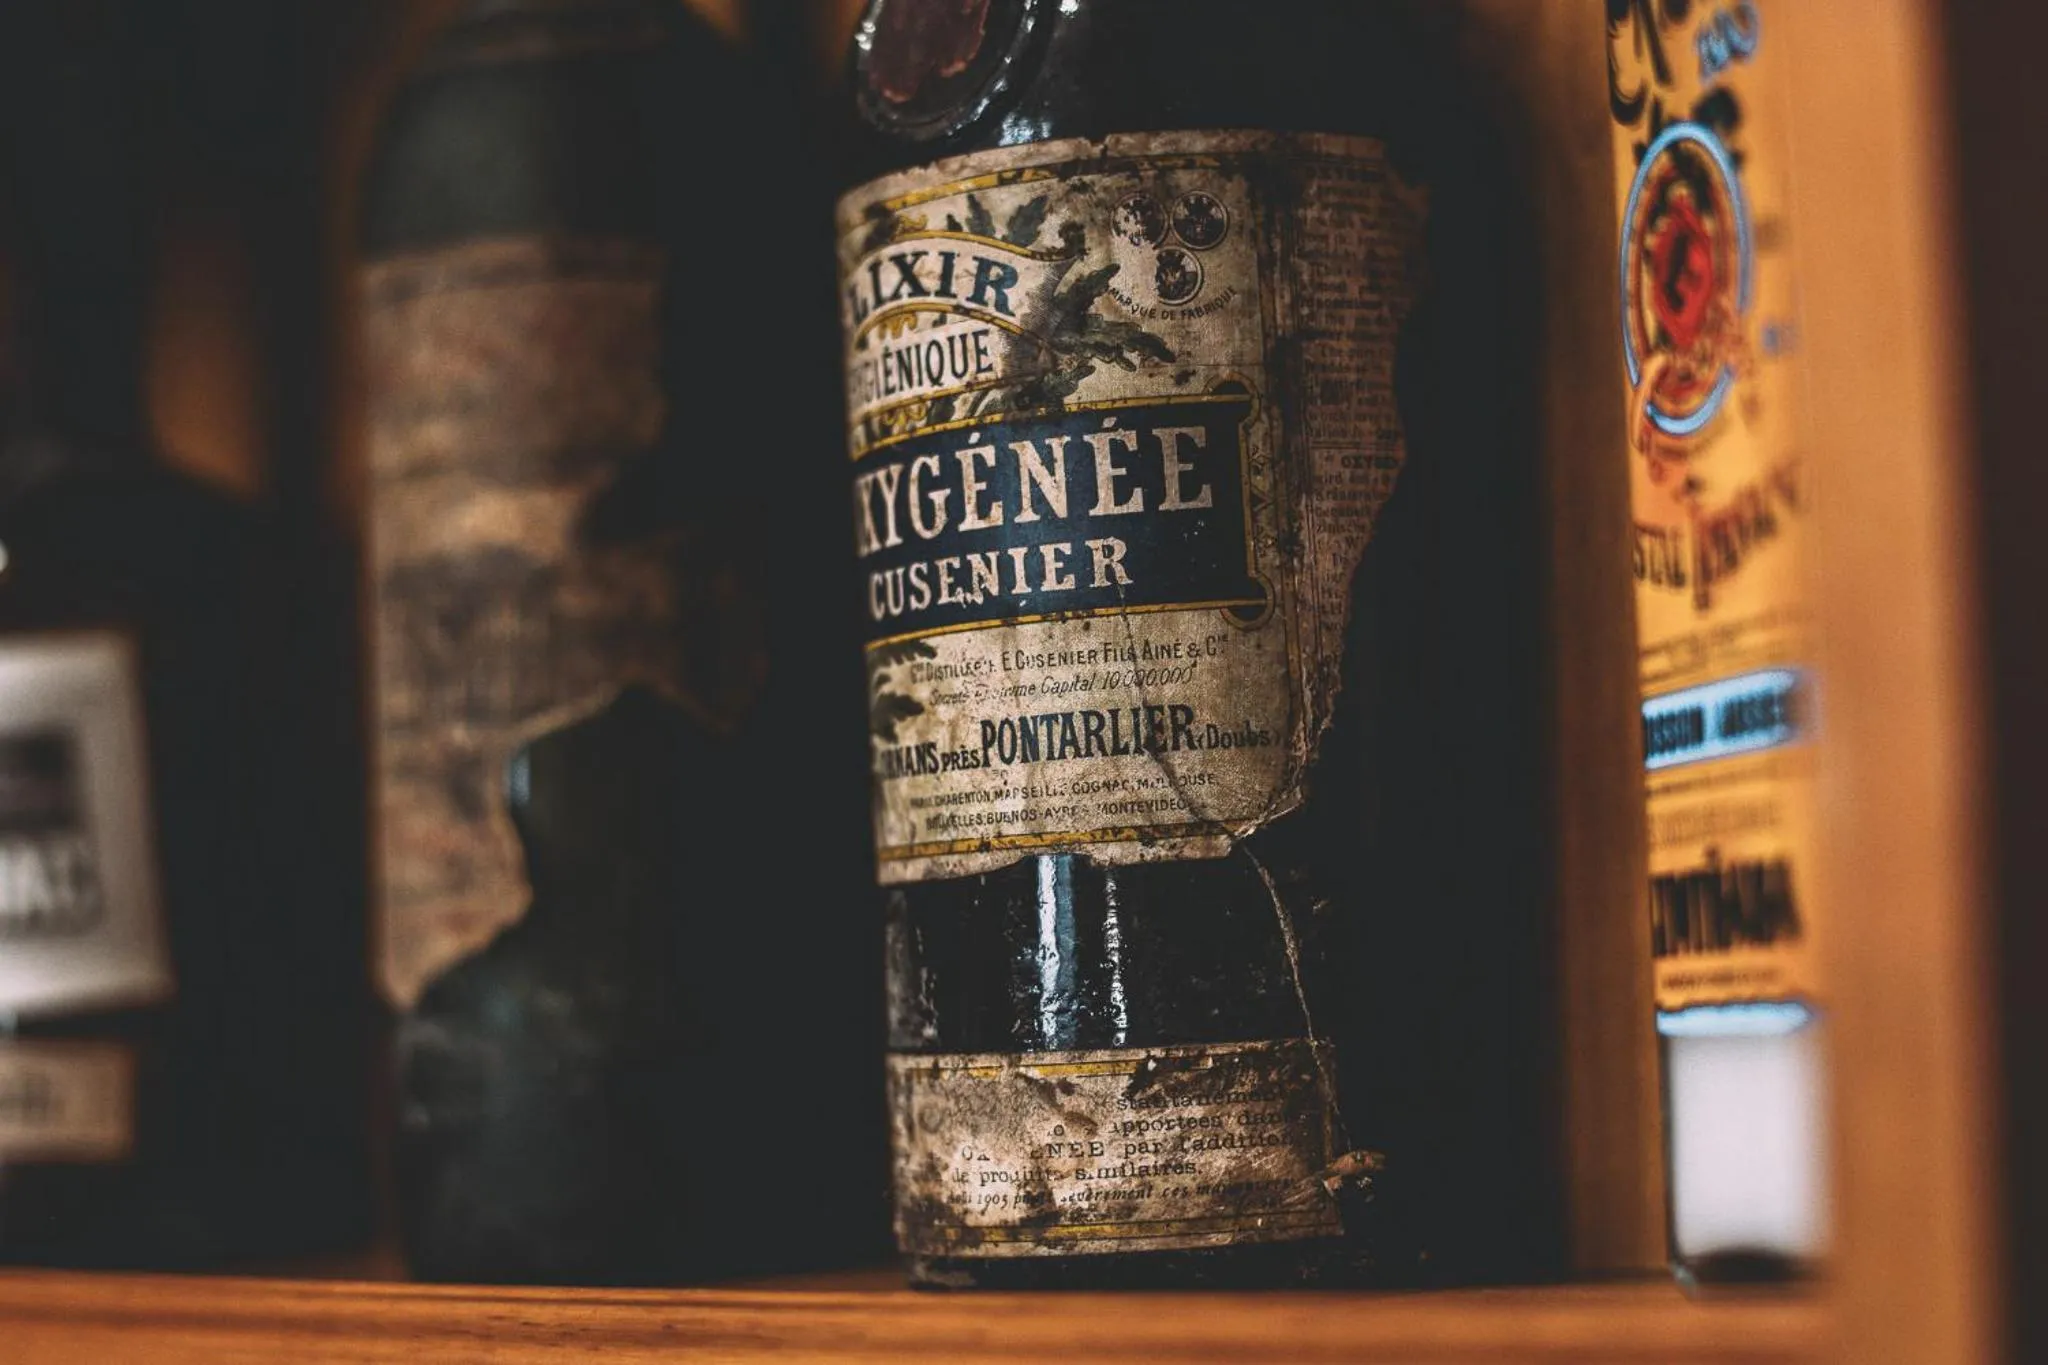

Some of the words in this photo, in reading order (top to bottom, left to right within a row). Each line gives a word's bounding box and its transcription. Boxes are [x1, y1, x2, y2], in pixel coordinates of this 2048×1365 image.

[1161, 310, 1179, 320] DE
[870, 536, 1134, 621] CUSENIER
[1187, 642, 1200, 658] &
[1041, 675, 1096, 699] Capital
[980, 703, 1199, 768] PONTARLIER
[1124, 1140, 1163, 1159] par
